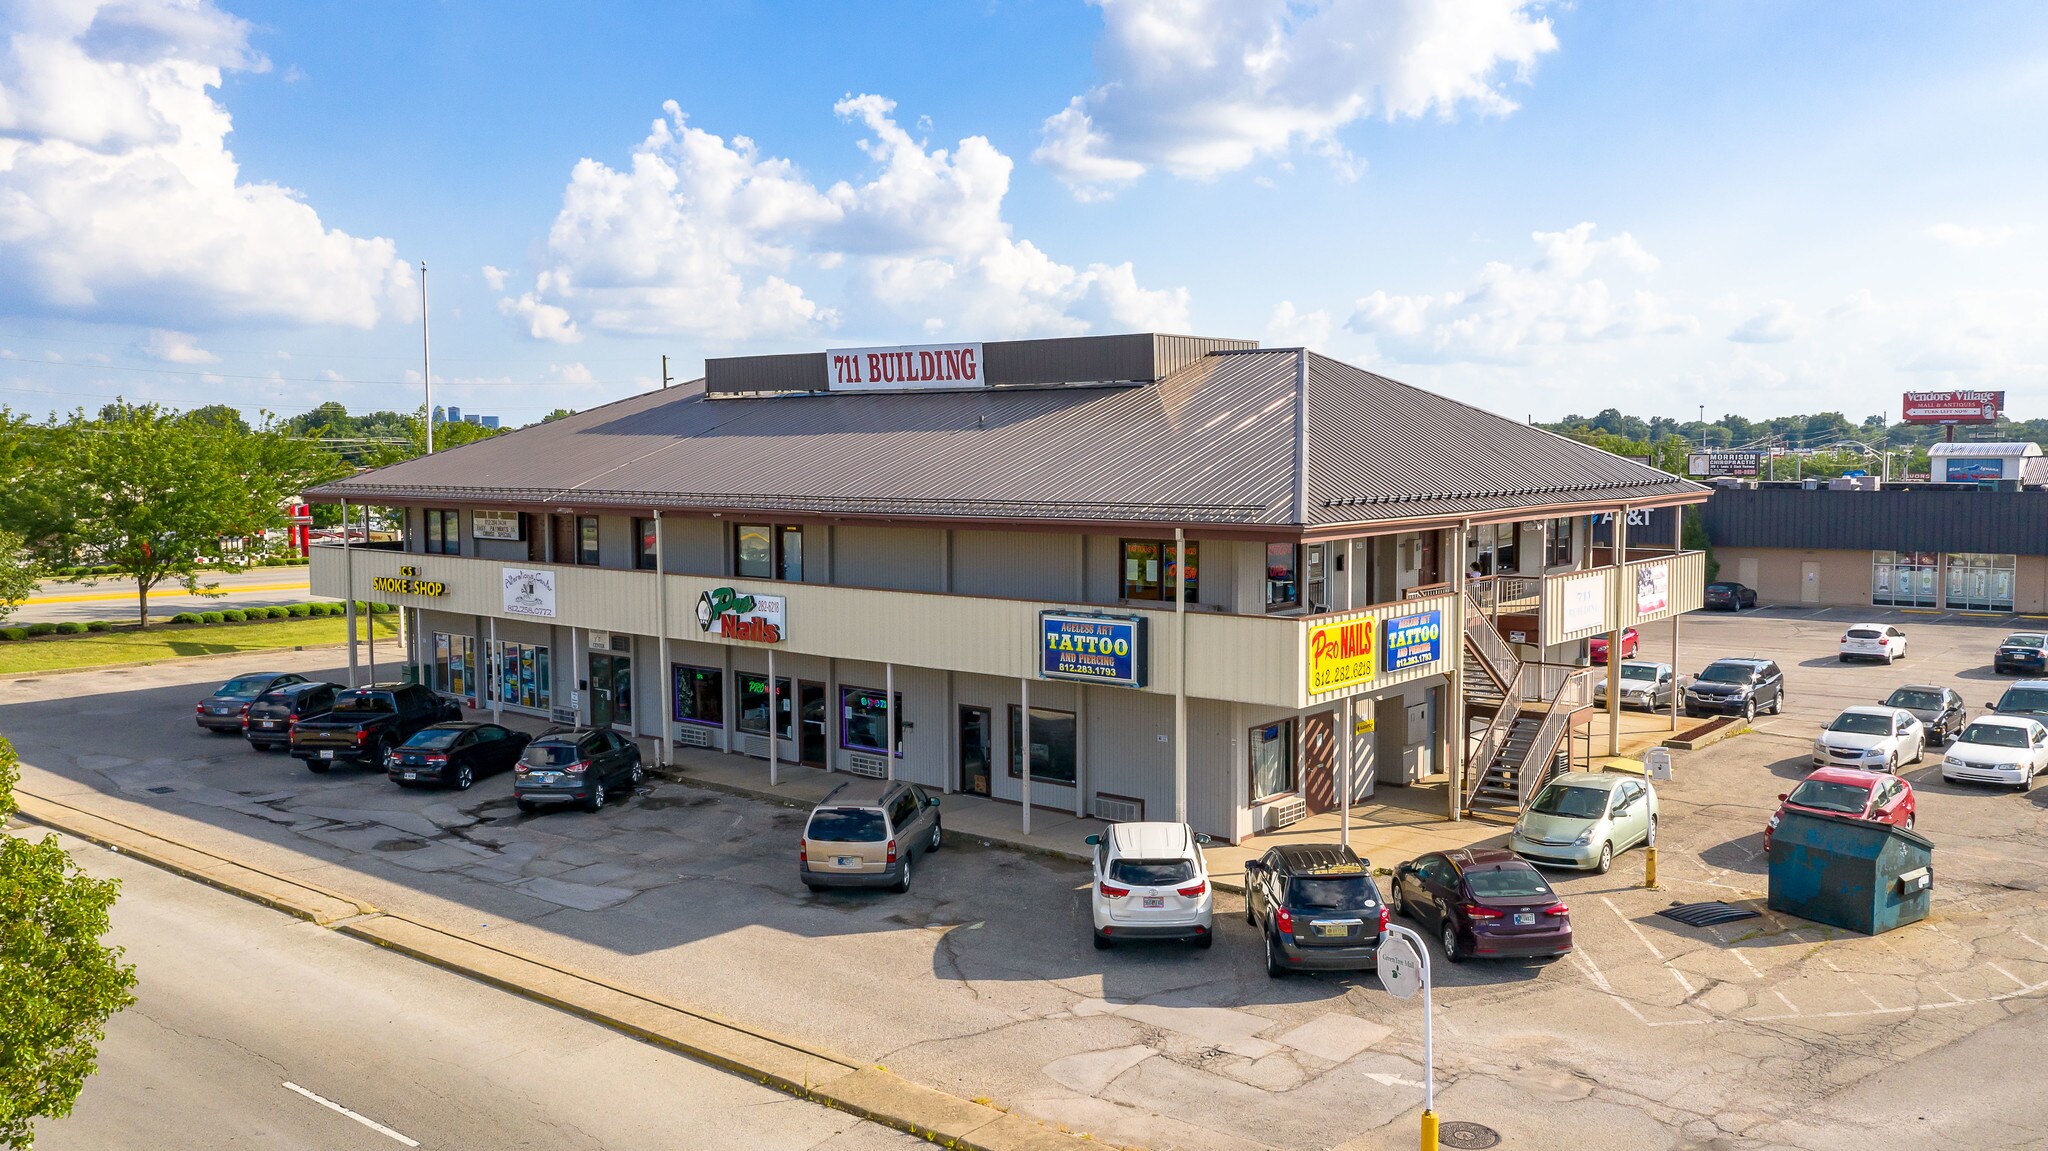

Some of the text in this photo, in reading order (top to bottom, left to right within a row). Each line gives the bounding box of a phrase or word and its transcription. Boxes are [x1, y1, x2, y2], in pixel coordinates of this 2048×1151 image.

[834, 348, 976, 383] 711 BUILDING
[1955, 390, 1994, 403] Village
[373, 577, 443, 597] SMOKE SHOP
[711, 587, 757, 620] Pro
[721, 614, 780, 644] Nails
[1061, 622, 1115, 636] AGELESS ART
[1340, 621, 1372, 660] NAILS
[1388, 623, 1439, 649] TATTOO
[1047, 632, 1129, 656] TATTOO
[1059, 662, 1117, 677] 812.283.1793
[1060, 652, 1115, 667] AND PIERCING
[1315, 660, 1371, 687] 812.282.6218
